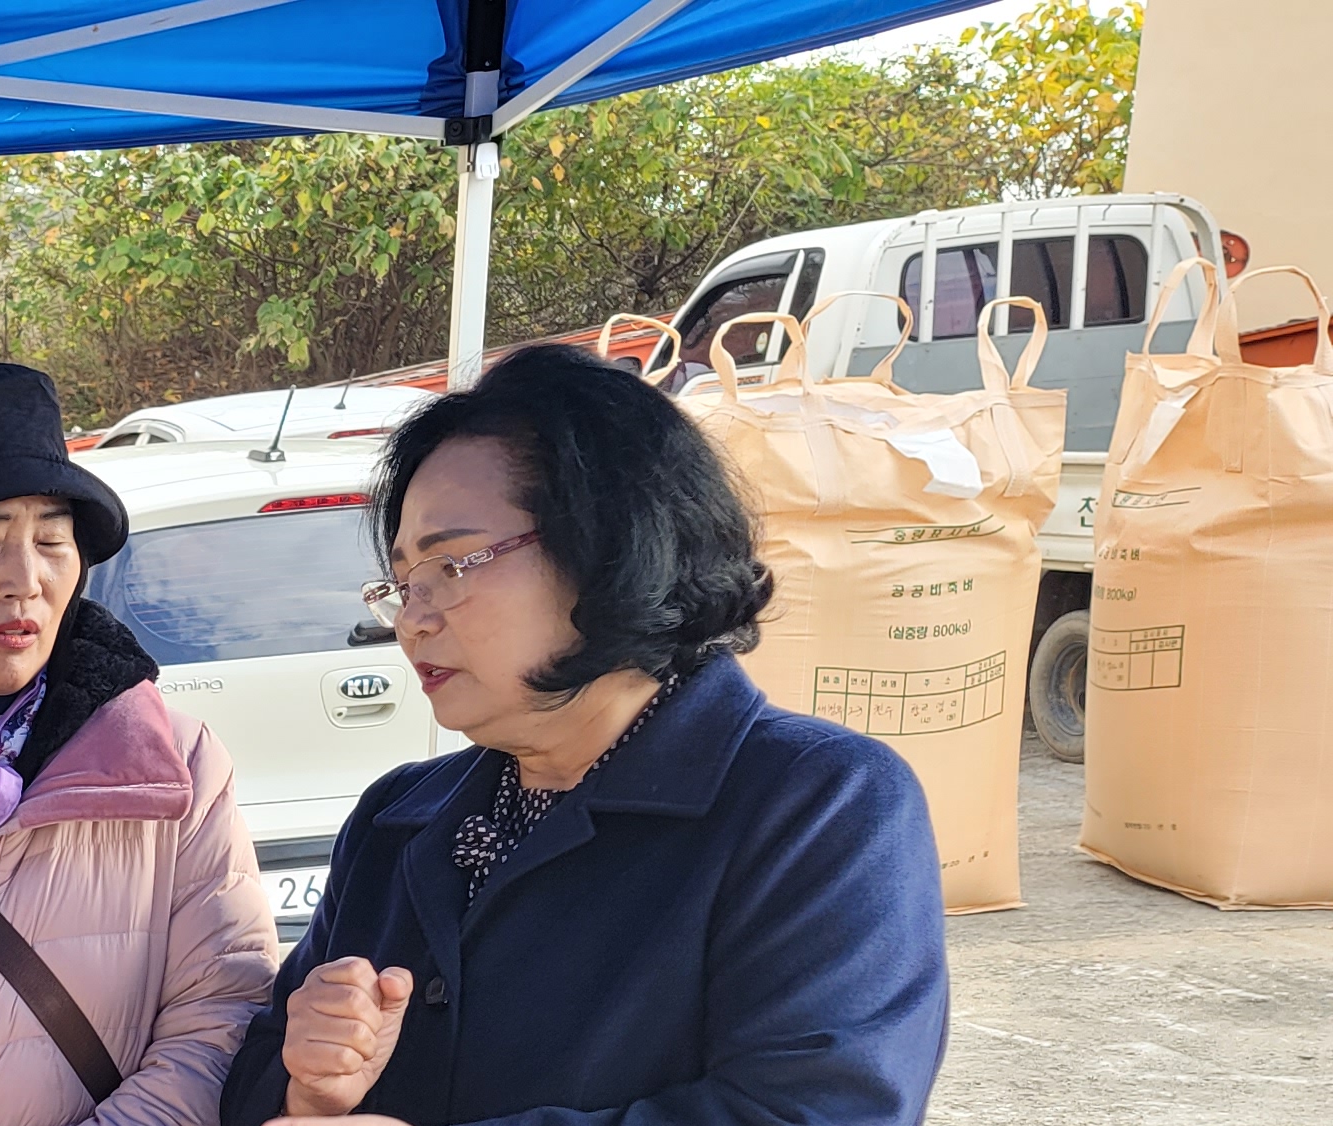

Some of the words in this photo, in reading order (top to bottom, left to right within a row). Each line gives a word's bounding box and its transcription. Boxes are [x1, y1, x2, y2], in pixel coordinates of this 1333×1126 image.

[932, 619, 972, 638] 800kg)
[346, 678, 384, 697] KIA
[278, 874, 323, 910] 26
